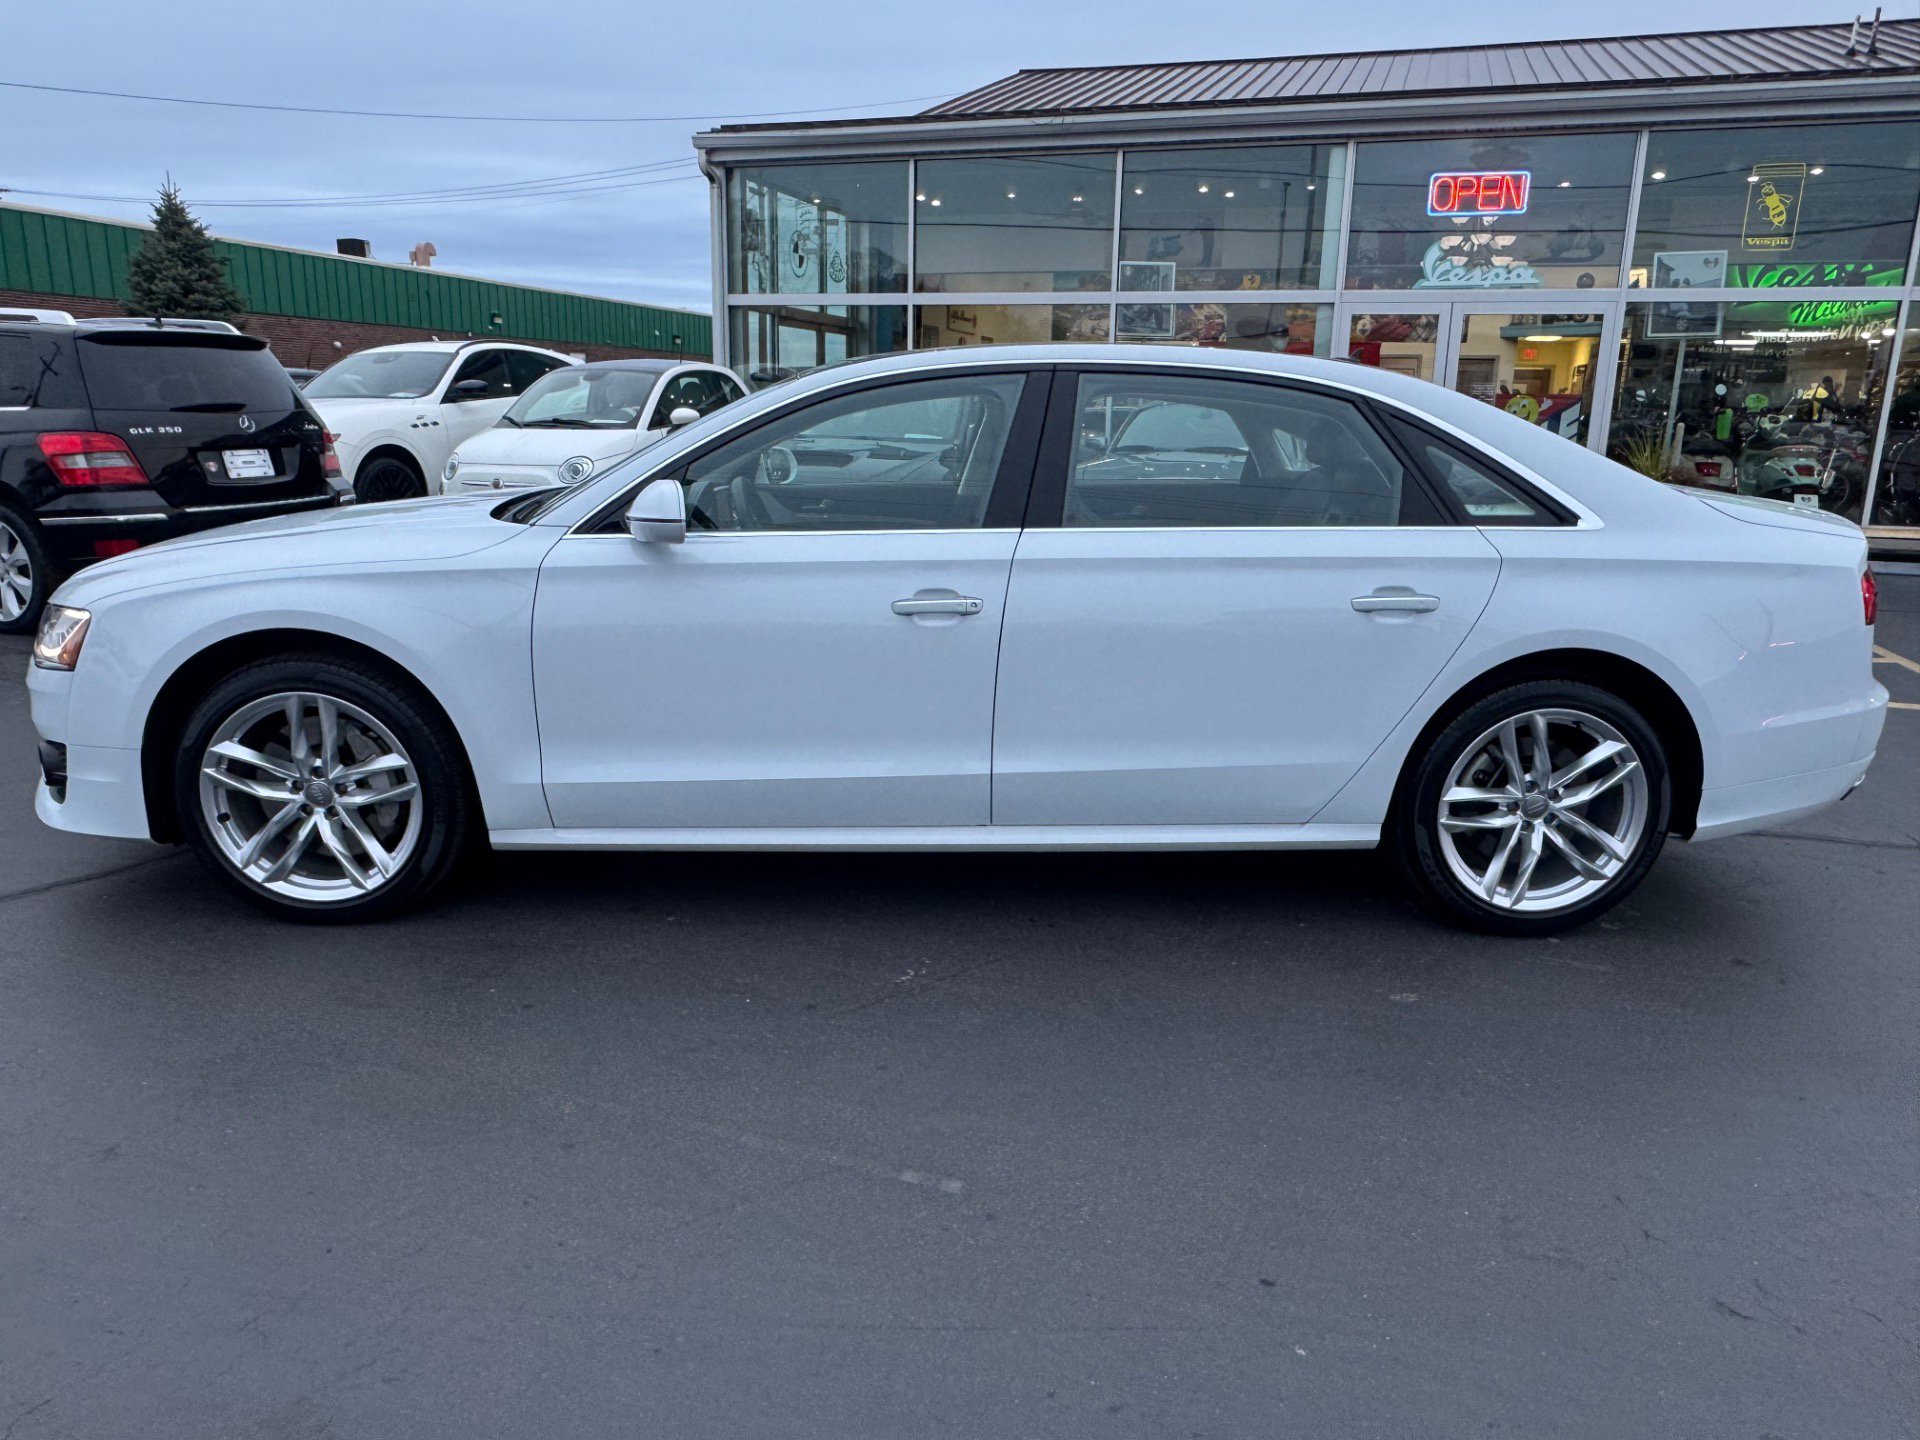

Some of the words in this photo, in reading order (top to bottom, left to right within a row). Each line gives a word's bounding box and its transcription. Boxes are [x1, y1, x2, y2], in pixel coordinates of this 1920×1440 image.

[1432, 175, 1526, 212] OPEN
[1412, 239, 1542, 289] Vespa
[129, 427, 154, 435] GLK
